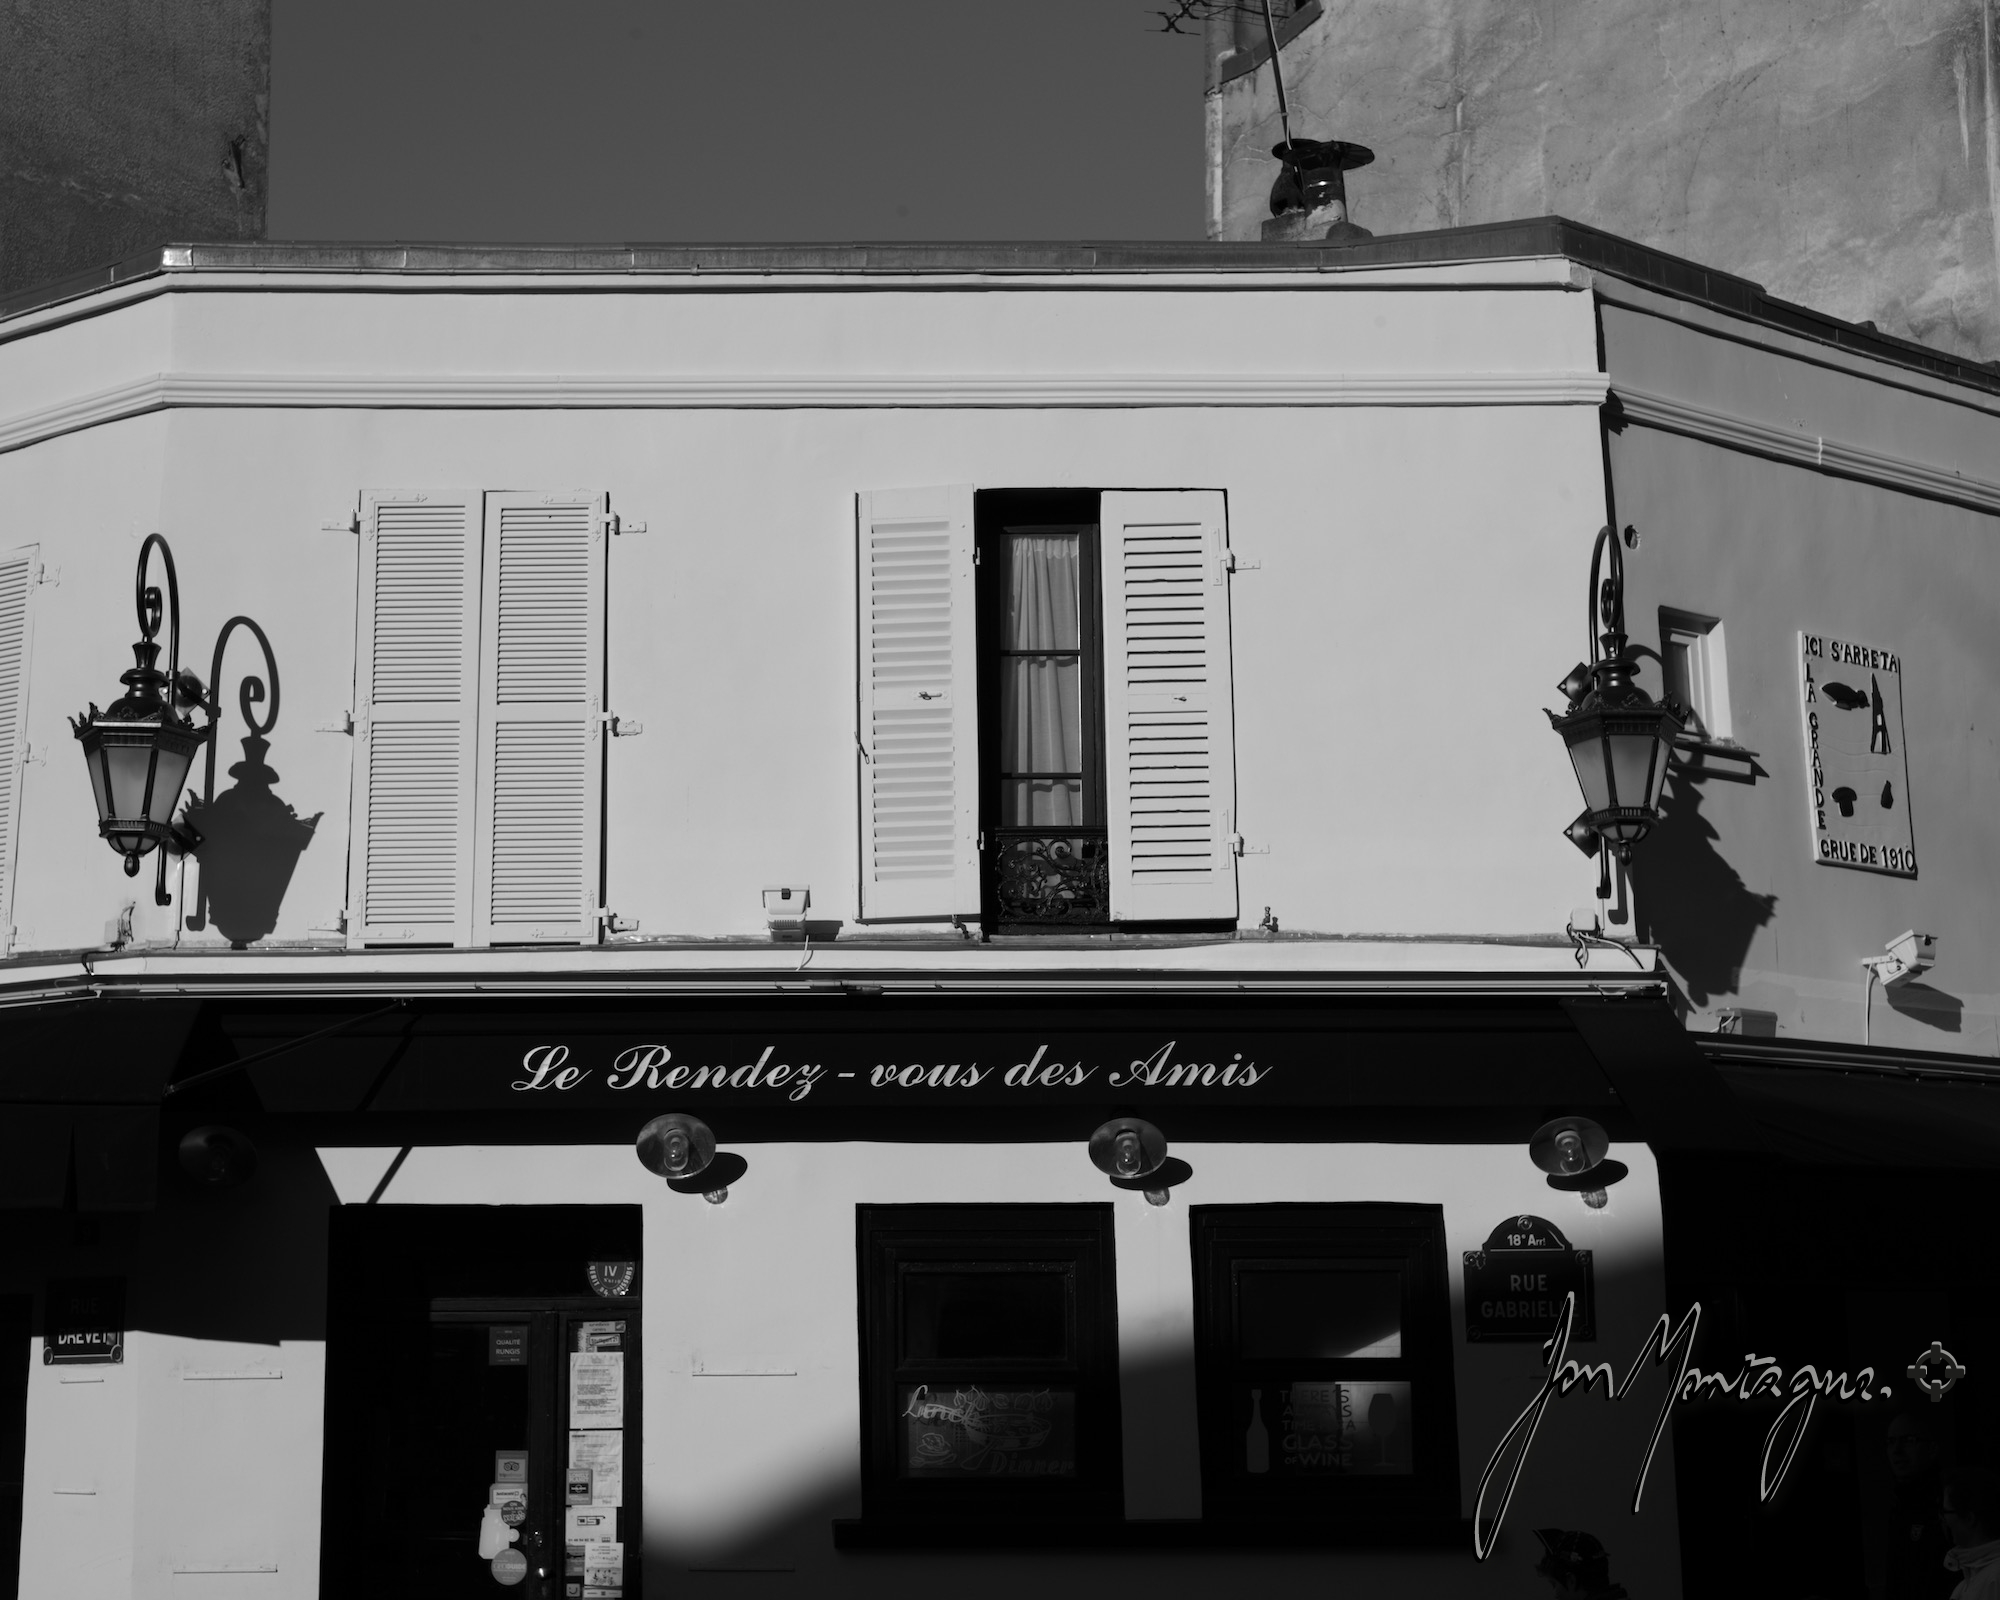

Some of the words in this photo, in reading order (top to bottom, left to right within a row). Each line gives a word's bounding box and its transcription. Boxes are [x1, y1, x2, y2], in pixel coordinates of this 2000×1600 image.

[1805, 635, 1823, 658] ICI
[1831, 641, 1898, 673] S'ARRETA
[1806, 663, 1817, 703] LA
[1859, 843, 1878, 865] DE
[1881, 845, 1915, 871] 1910
[511, 1045, 592, 1090] Le
[606, 1044, 827, 1101] Rendez
[1004, 1044, 1098, 1086] des
[1108, 1040, 1272, 1086] Amis
[1509, 1273, 1548, 1293] RUE
[70, 1298, 100, 1315] RUE
[1282, 1433, 1354, 1450] GLASS
[988, 1450, 1076, 1475] Dinner
[1284, 1456, 1297, 1465] OF
[1298, 1451, 1353, 1467] WINE
